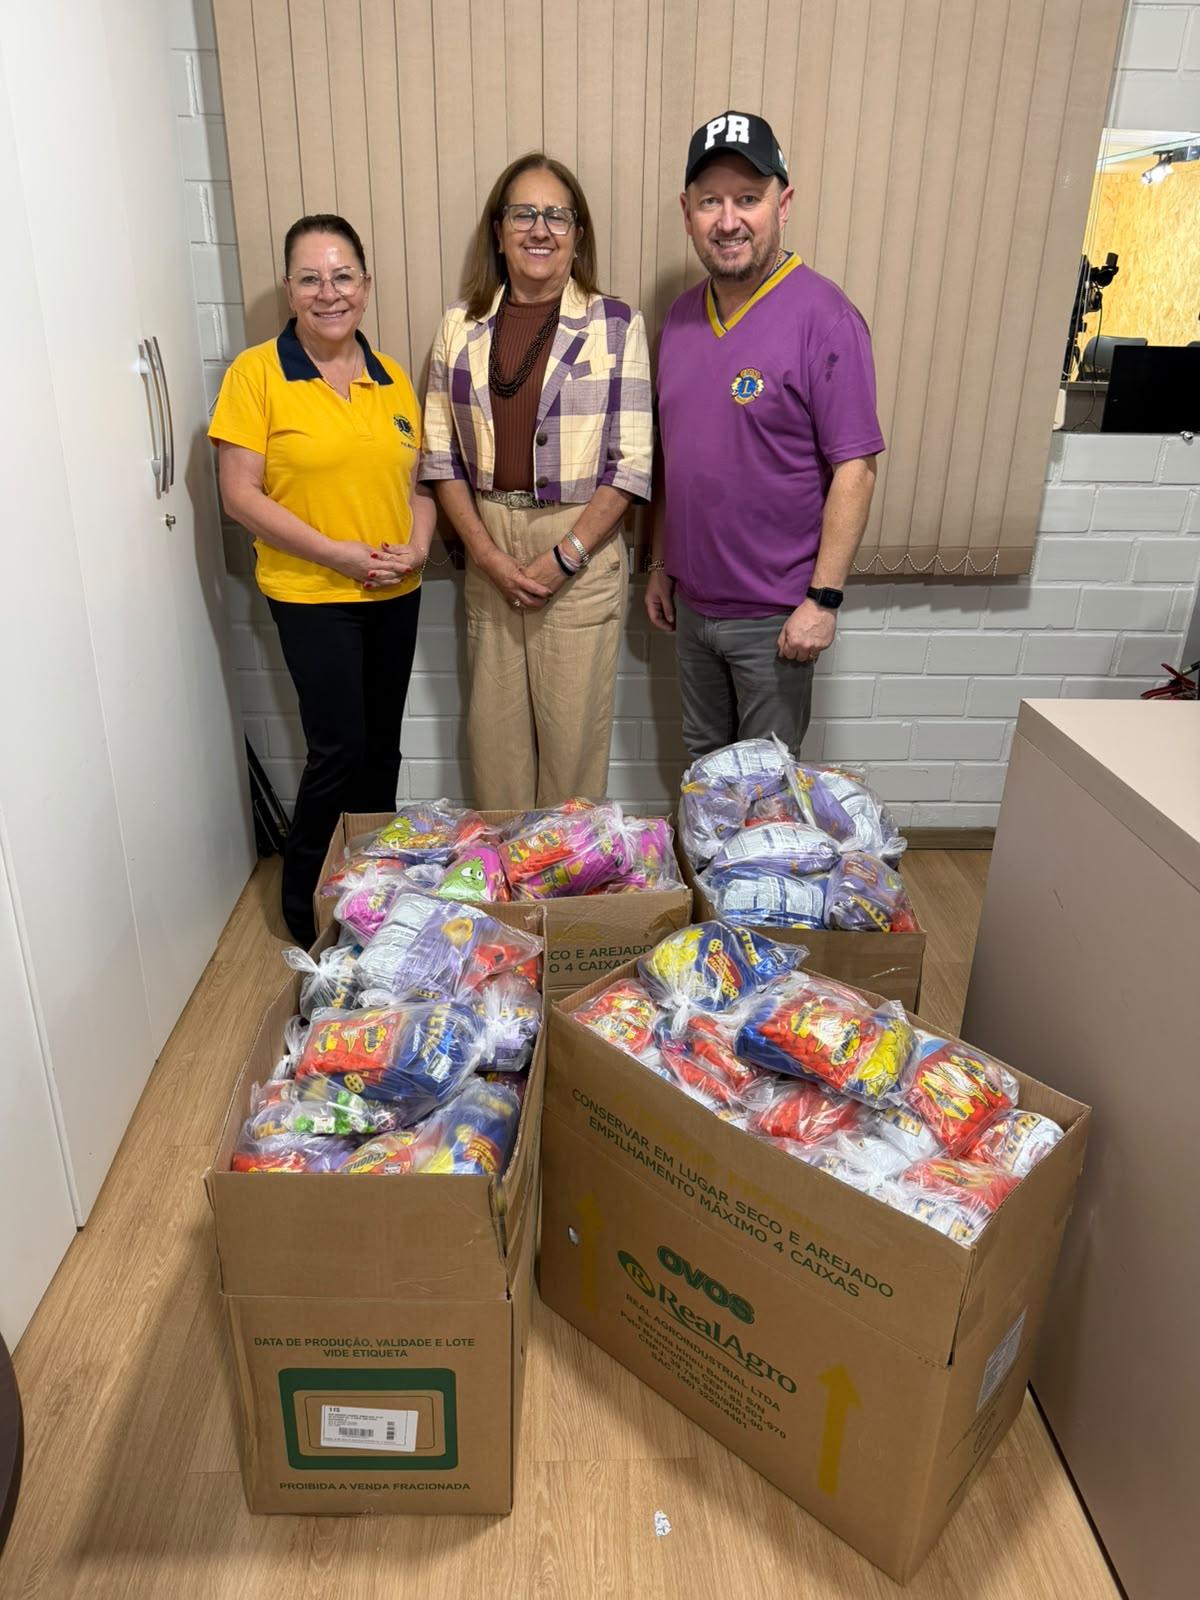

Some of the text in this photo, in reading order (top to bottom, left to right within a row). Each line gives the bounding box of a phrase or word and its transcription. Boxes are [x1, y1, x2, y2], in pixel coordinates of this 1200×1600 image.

[704, 114, 750, 150] PR
[576, 949, 584, 959] E
[564, 962, 573, 972] 4
[572, 1089, 894, 1298] CONSERVAR EM LUGAR SECO E AREJADO
[589, 1116, 860, 1297] EMPILHAMENTO MÁXIMO 4 CAIXAS
[254, 1337, 475, 1349] DATA DE PRODUÇÃO, VALIDADE E LOTE
[658, 1282, 797, 1394] RealAgro
[323, 1350, 408, 1358] VIDE ETIQUETA
[626, 1293, 779, 1412] REAL AGROINDUSTRIAL LTDA
[279, 1482, 471, 1490] PROIBIDA A VENDA FRACIONADA
